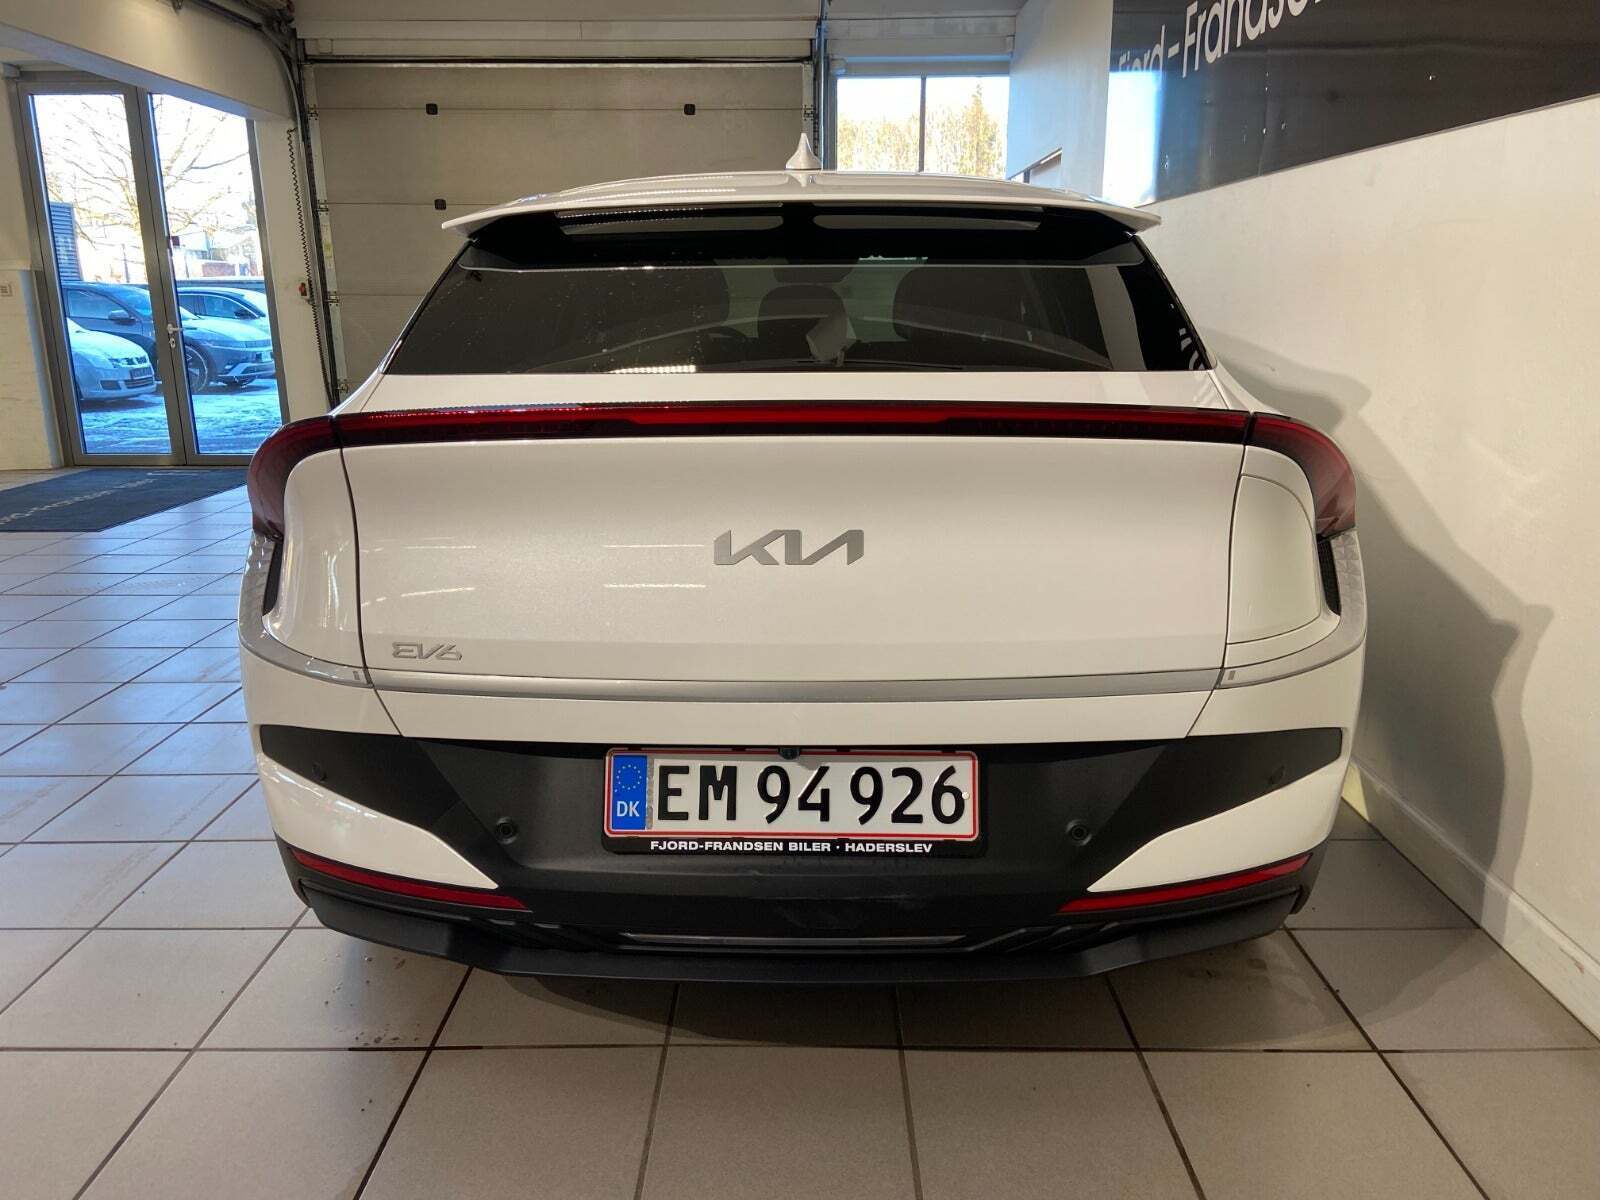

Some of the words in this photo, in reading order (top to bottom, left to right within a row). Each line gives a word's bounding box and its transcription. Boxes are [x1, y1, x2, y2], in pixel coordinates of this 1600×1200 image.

[713, 529, 865, 566] KIA
[392, 642, 462, 661] EV6
[657, 765, 737, 821] EM
[757, 765, 830, 825] 94
[850, 765, 965, 825] 926
[616, 801, 640, 817] DK
[650, 840, 784, 851] FJORD-FRANDSEN
[788, 842, 831, 852] BILER
[845, 843, 933, 853] HADERSLEV
